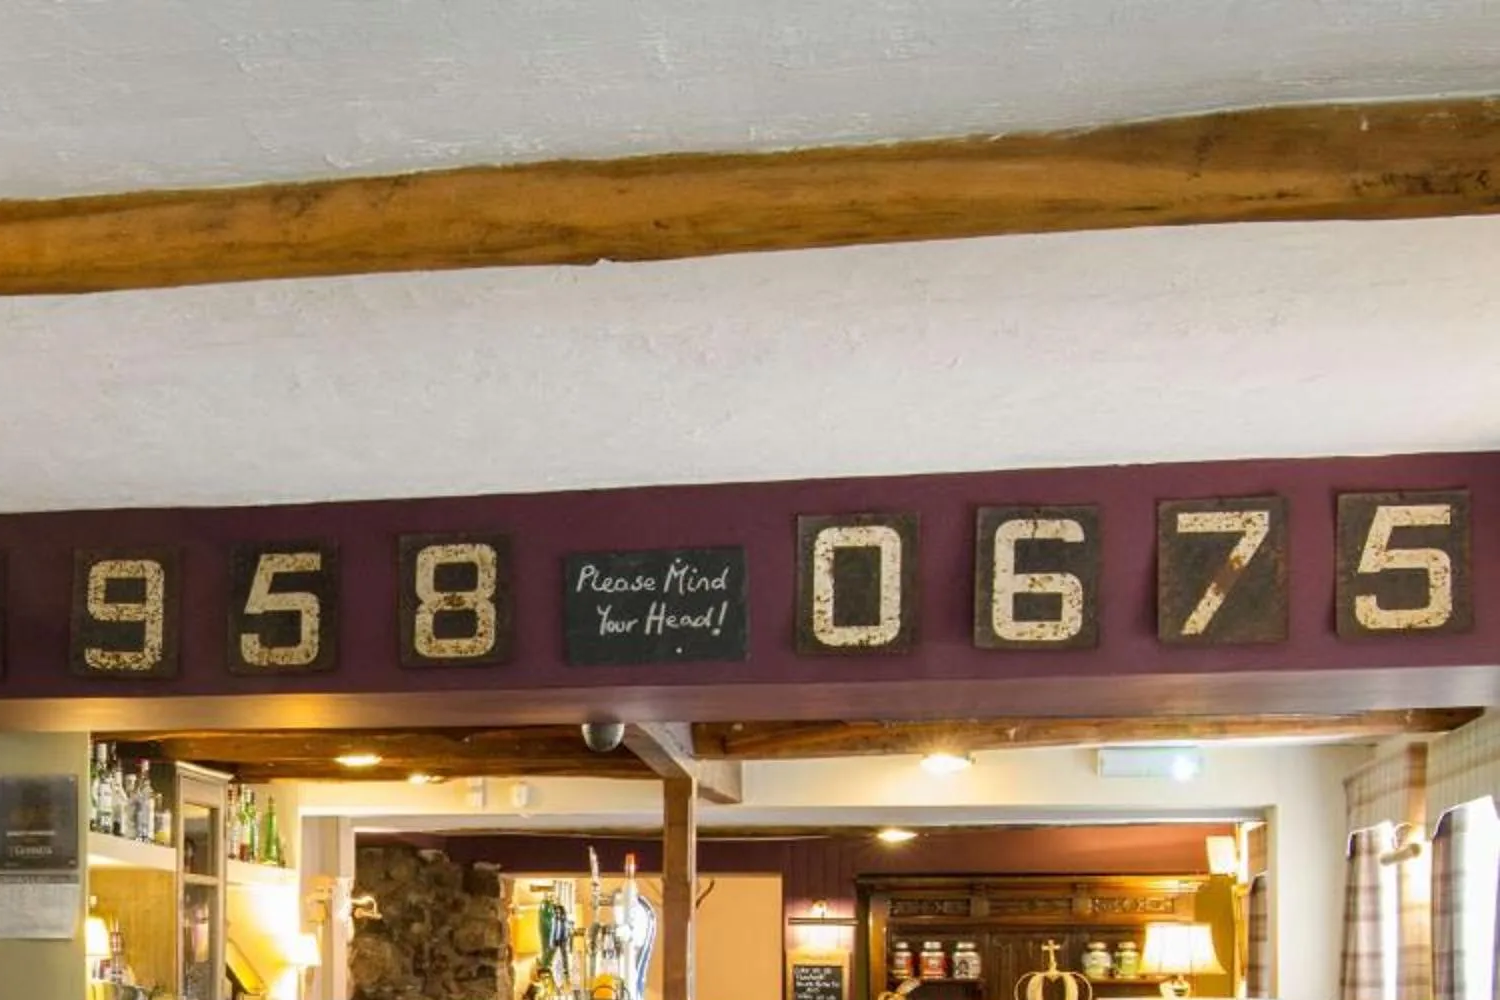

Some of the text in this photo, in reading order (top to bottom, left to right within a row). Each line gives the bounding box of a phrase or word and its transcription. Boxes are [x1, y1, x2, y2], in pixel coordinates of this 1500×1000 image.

[84, 559, 165, 670] 9
[240, 551, 322, 666] 5
[414, 543, 497, 658] 8
[576, 563, 730, 595] Please Mind
[812, 503, 1452, 647] 0 6 7 5
[596, 600, 728, 636] Your Head!
